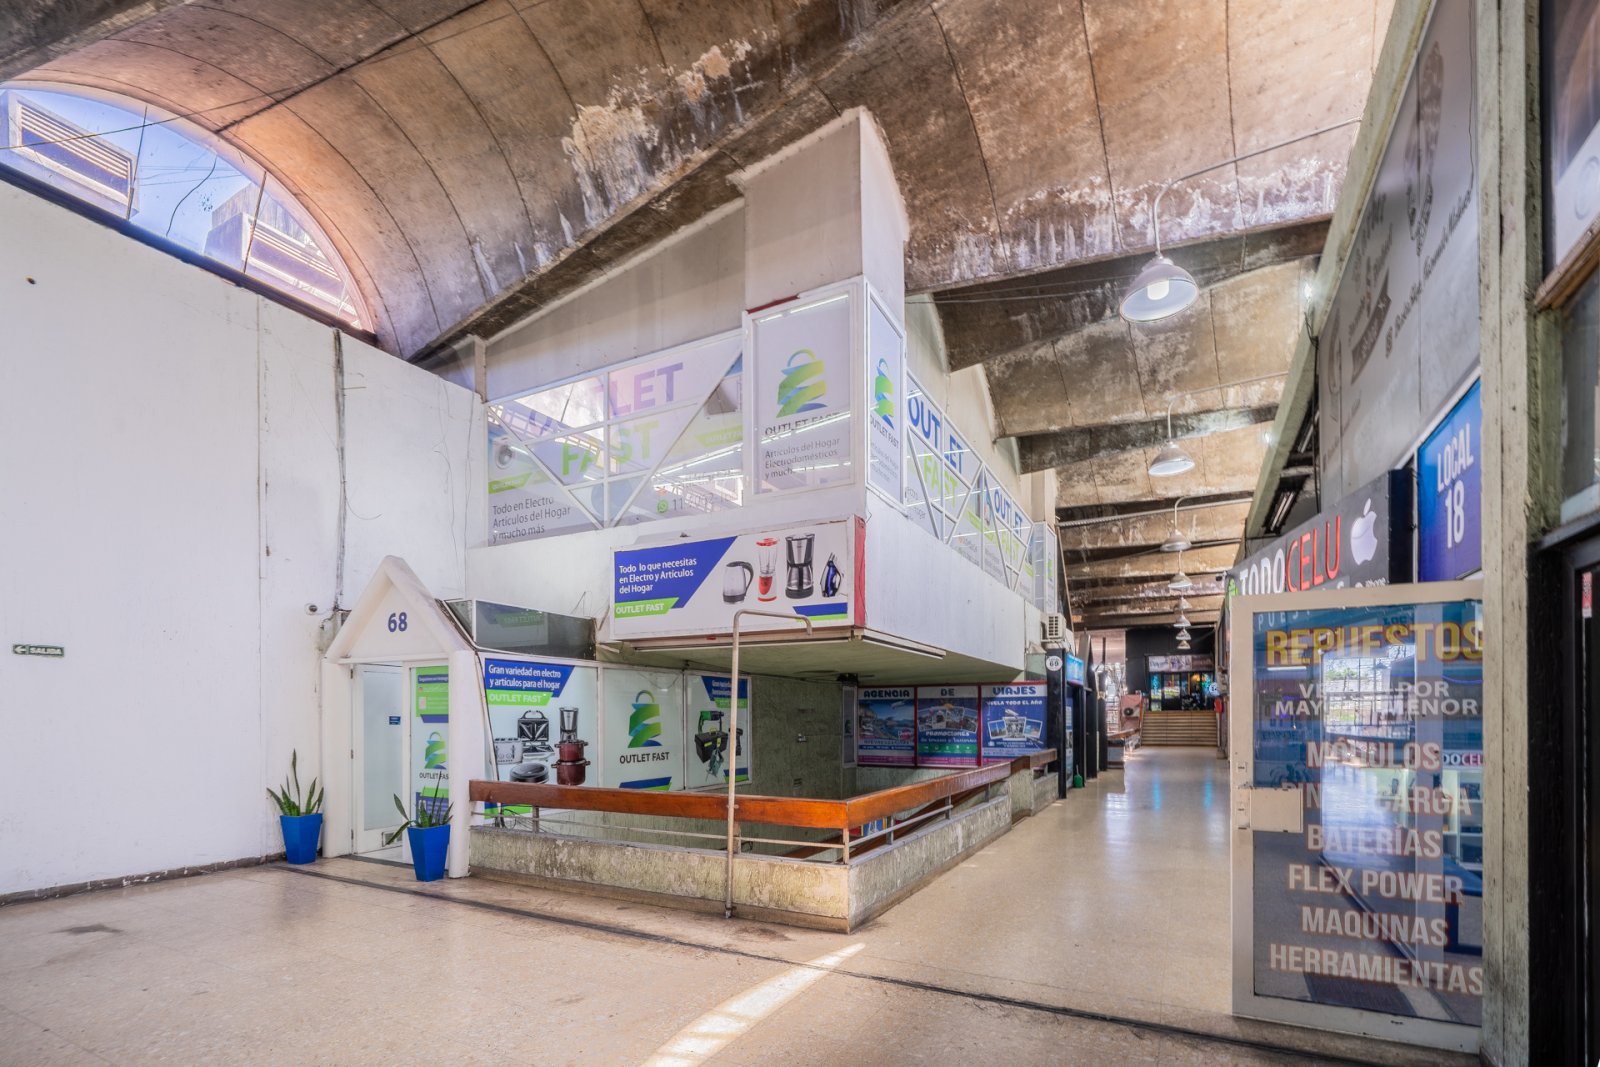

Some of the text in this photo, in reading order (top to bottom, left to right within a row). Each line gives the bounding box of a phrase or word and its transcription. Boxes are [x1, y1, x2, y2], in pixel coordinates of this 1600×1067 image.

[765, 418, 808, 437] OUTLET
[908, 396, 964, 475] OUTET
[801, 441, 814, 452] del
[815, 438, 840, 451] Hogar
[1436, 422, 1474, 491] LOCAL
[770, 467, 796, 478] much
[492, 496, 554, 516] Todo en Electro
[529, 510, 543, 522] del
[544, 505, 571, 521] Hogar
[1445, 480, 1465, 549] 18
[994, 491, 1023, 543] OUTET
[492, 523, 545, 544] y mucho más
[1240, 514, 1341, 595] TODOCELU
[619, 557, 697, 574] Todo lo que necesitas
[619, 576, 628, 584] en
[629, 573, 654, 583] Electro
[619, 584, 654, 594] del Hogar
[615, 603, 664, 614] OUTLET FAST
[388, 611, 408, 632] 68
[1265, 620, 1483, 667] REPUESTOS
[488, 664, 561, 678] Gran variedad en electro
[523, 680, 536, 690] para
[537, 679, 543, 687] el
[543, 680, 561, 691] hogar
[863, 689, 910, 698] AGENCIA
[941, 688, 955, 696] DE
[490, 693, 542, 703] OUTLET FAST
[1388, 698, 1480, 718] MENOR
[620, 751, 670, 764] OUTLET FAST
[419, 772, 439, 780] OUTLET
[1307, 822, 1442, 858] BATERÍAS
[1287, 863, 1464, 905] FLEX POWER
[1301, 905, 1450, 947] MAQUINAS
[1269, 942, 1483, 996] HERRAMIENTAS
